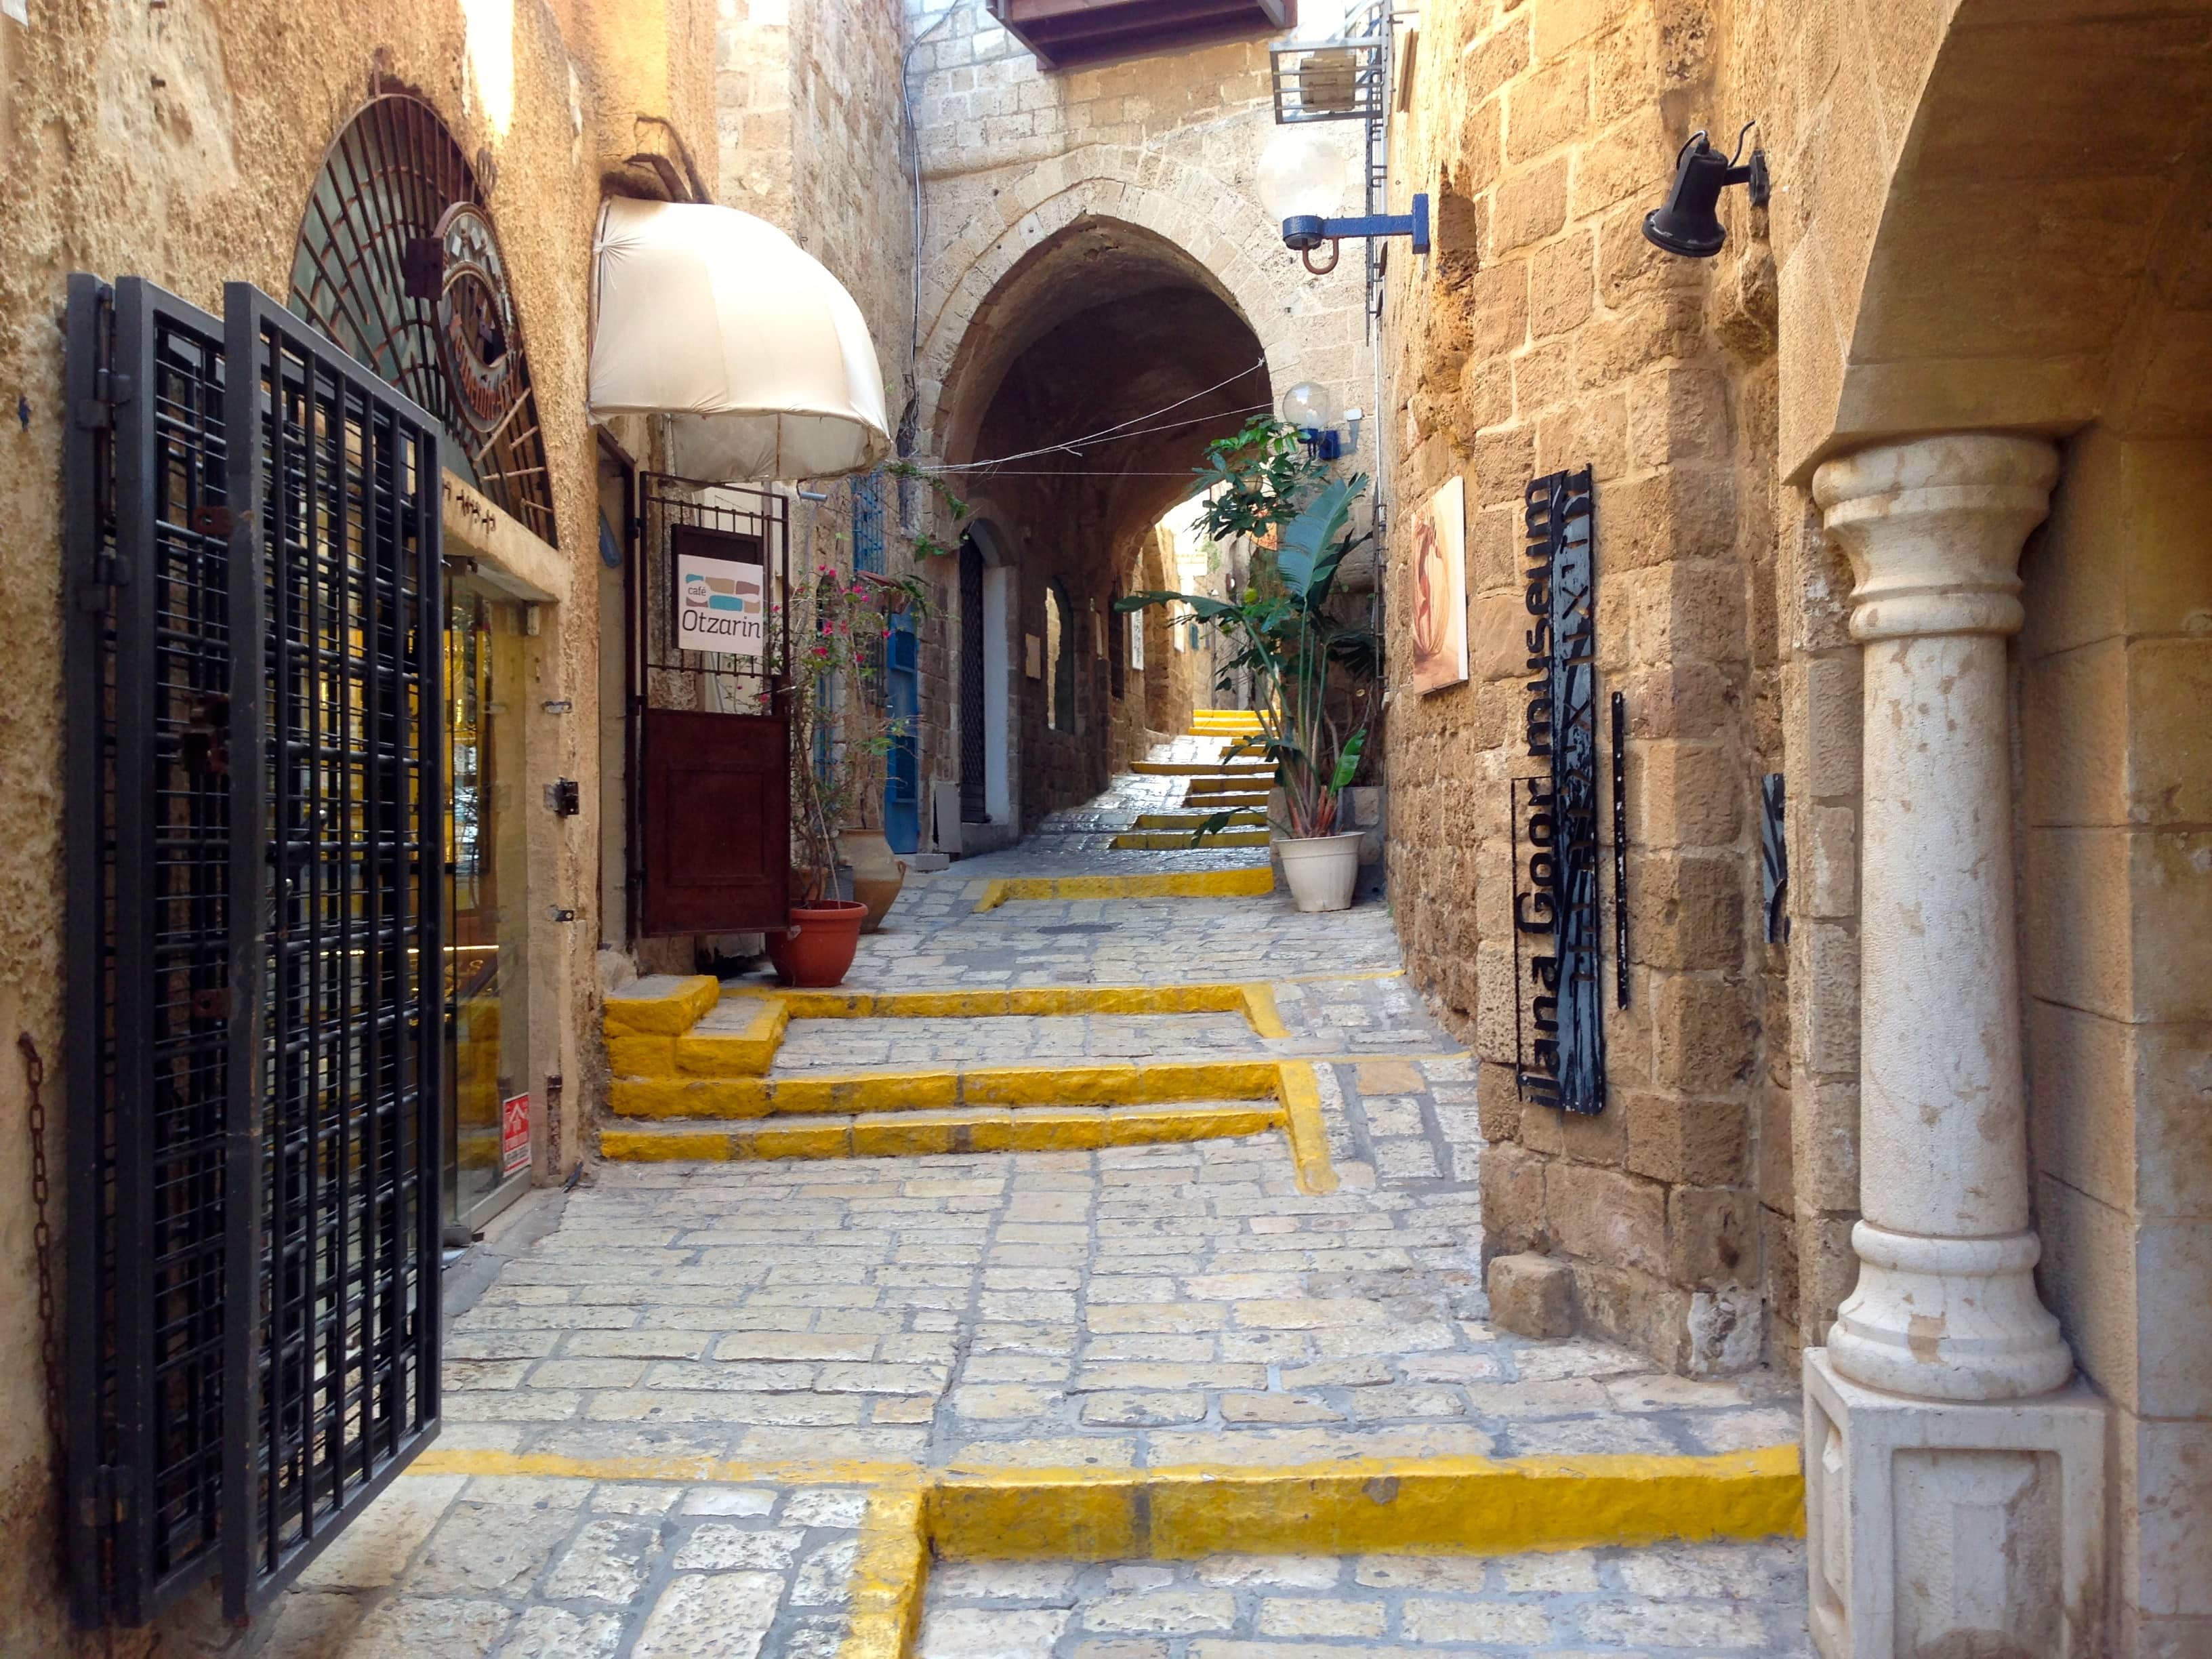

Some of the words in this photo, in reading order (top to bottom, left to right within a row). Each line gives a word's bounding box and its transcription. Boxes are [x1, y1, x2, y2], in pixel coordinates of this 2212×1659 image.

[682, 609, 761, 638] Otzarin
[687, 586, 706, 596] café
[1525, 473, 1554, 757] museum
[1516, 777, 1557, 934] Goor
